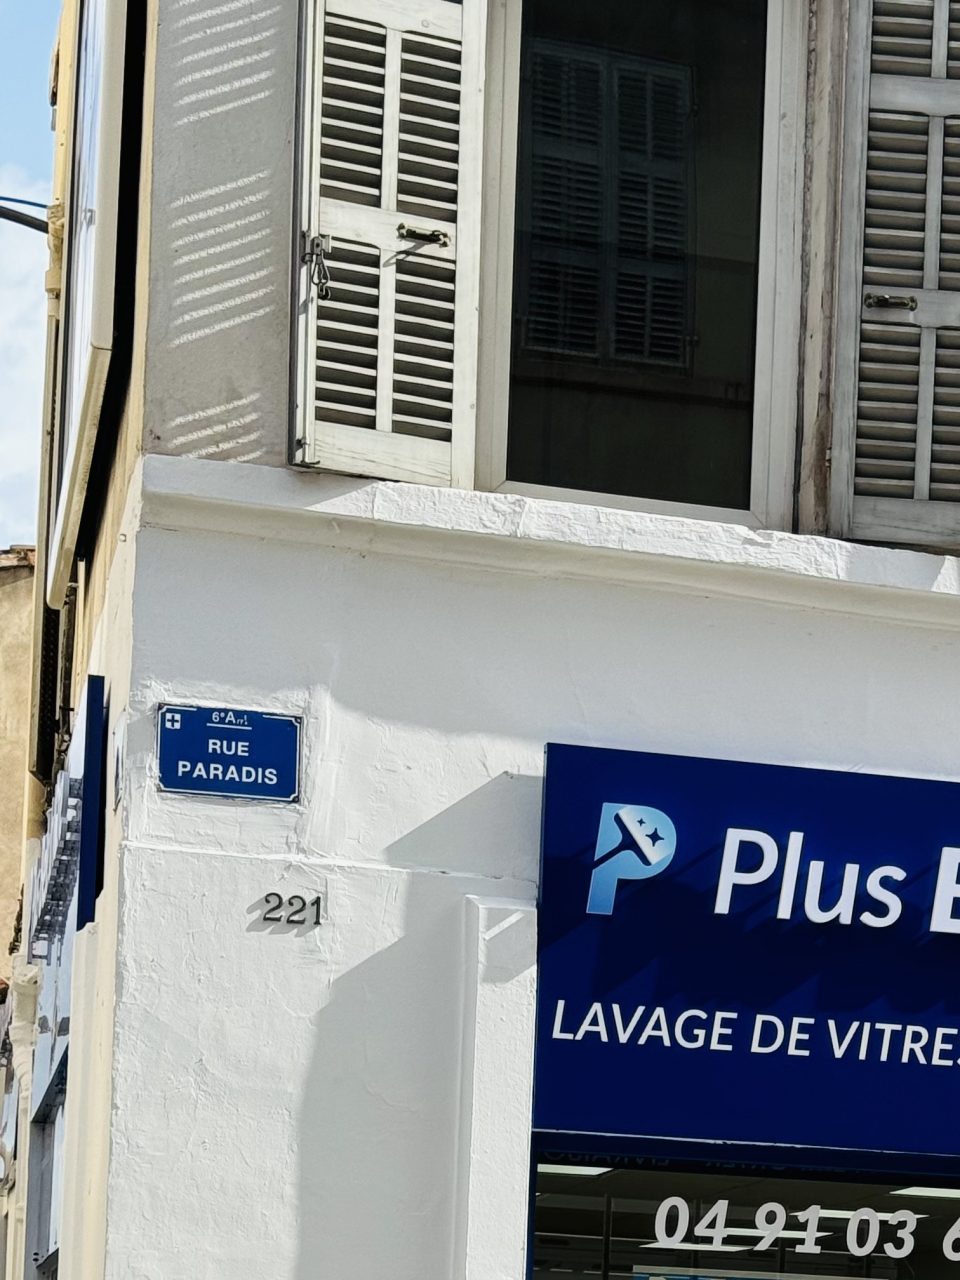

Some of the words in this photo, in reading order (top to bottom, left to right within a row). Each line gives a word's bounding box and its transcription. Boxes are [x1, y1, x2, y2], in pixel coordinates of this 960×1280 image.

[208, 739, 250, 757] RUE
[177, 760, 278, 785] PARADIS
[713, 827, 907, 928] Plus
[263, 892, 322, 926] 221
[551, 999, 738, 1051] LAVAGE
[750, 1014, 815, 1057] DE
[653, 1196, 729, 1248] 04
[752, 1201, 822, 1254] 91
[845, 1207, 918, 1259] 03
